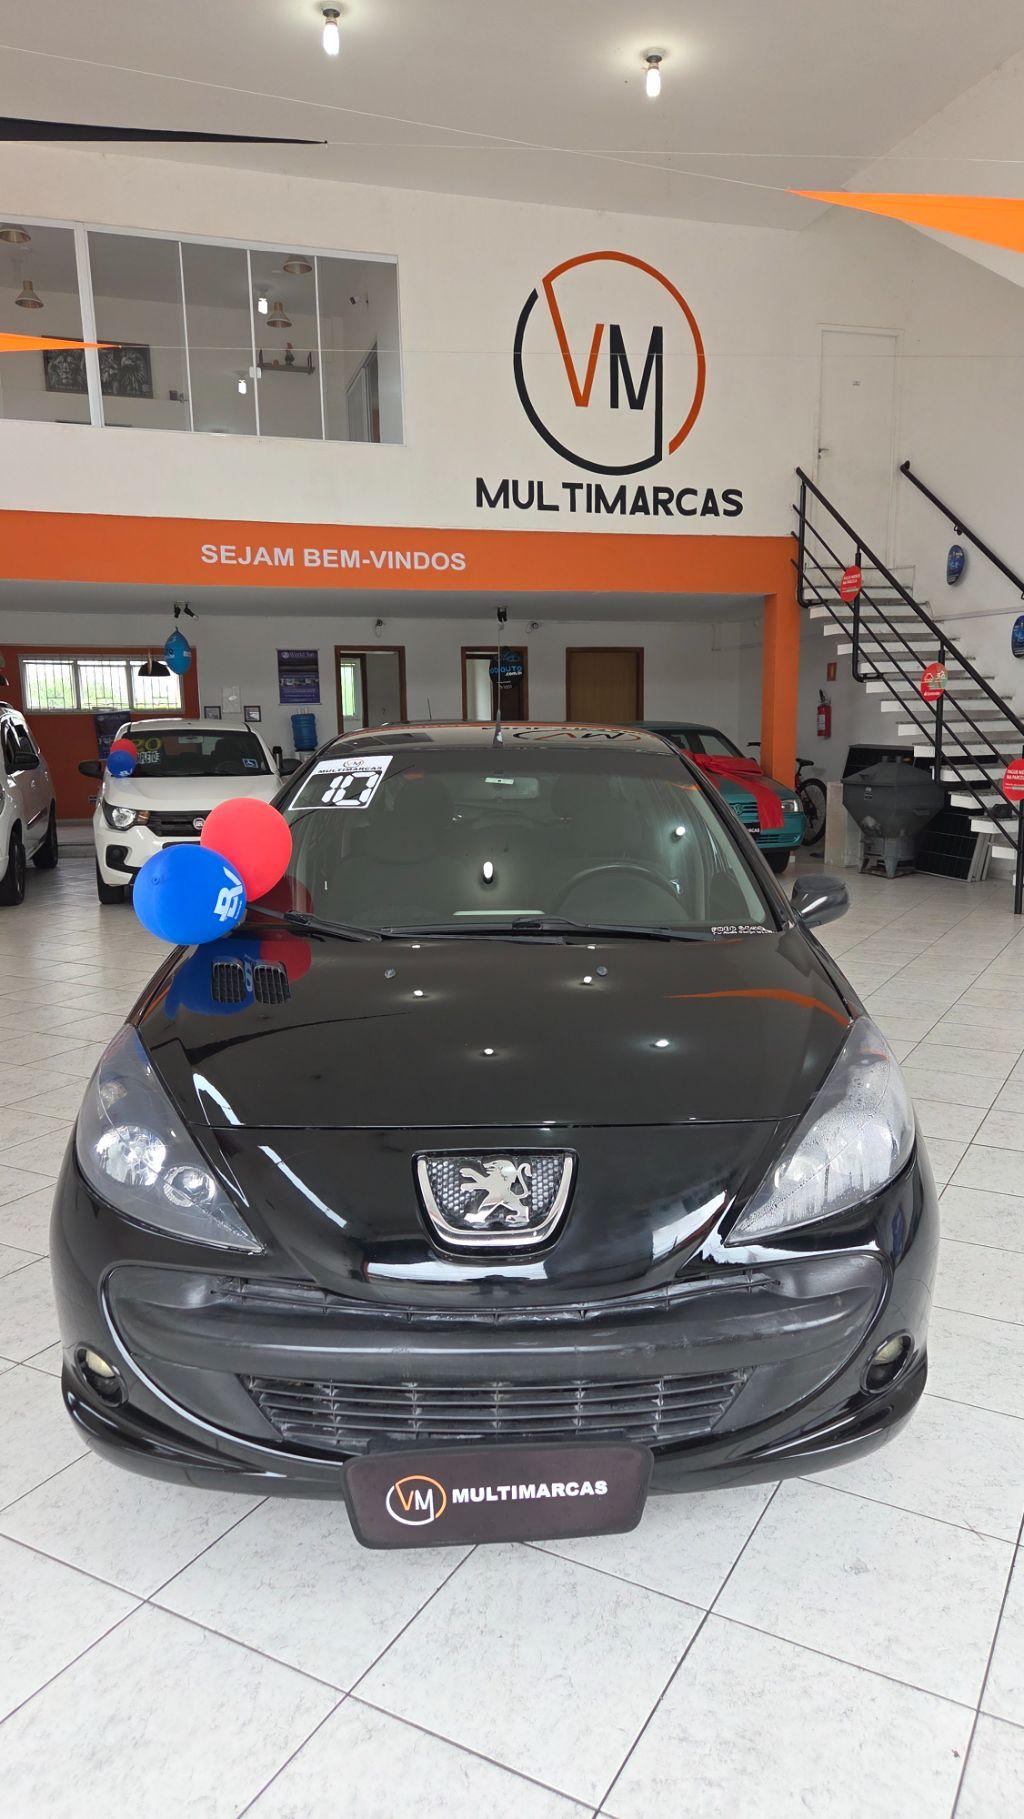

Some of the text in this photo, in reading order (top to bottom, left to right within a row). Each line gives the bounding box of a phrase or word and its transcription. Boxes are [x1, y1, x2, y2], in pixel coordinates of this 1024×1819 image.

[475, 477, 744, 518] MULTIMARCAS
[201, 544, 467, 571] SEJAM BEM-VINDOS
[321, 771, 380, 806] 10
[452, 1480, 608, 1504] MULTIMARCAS
